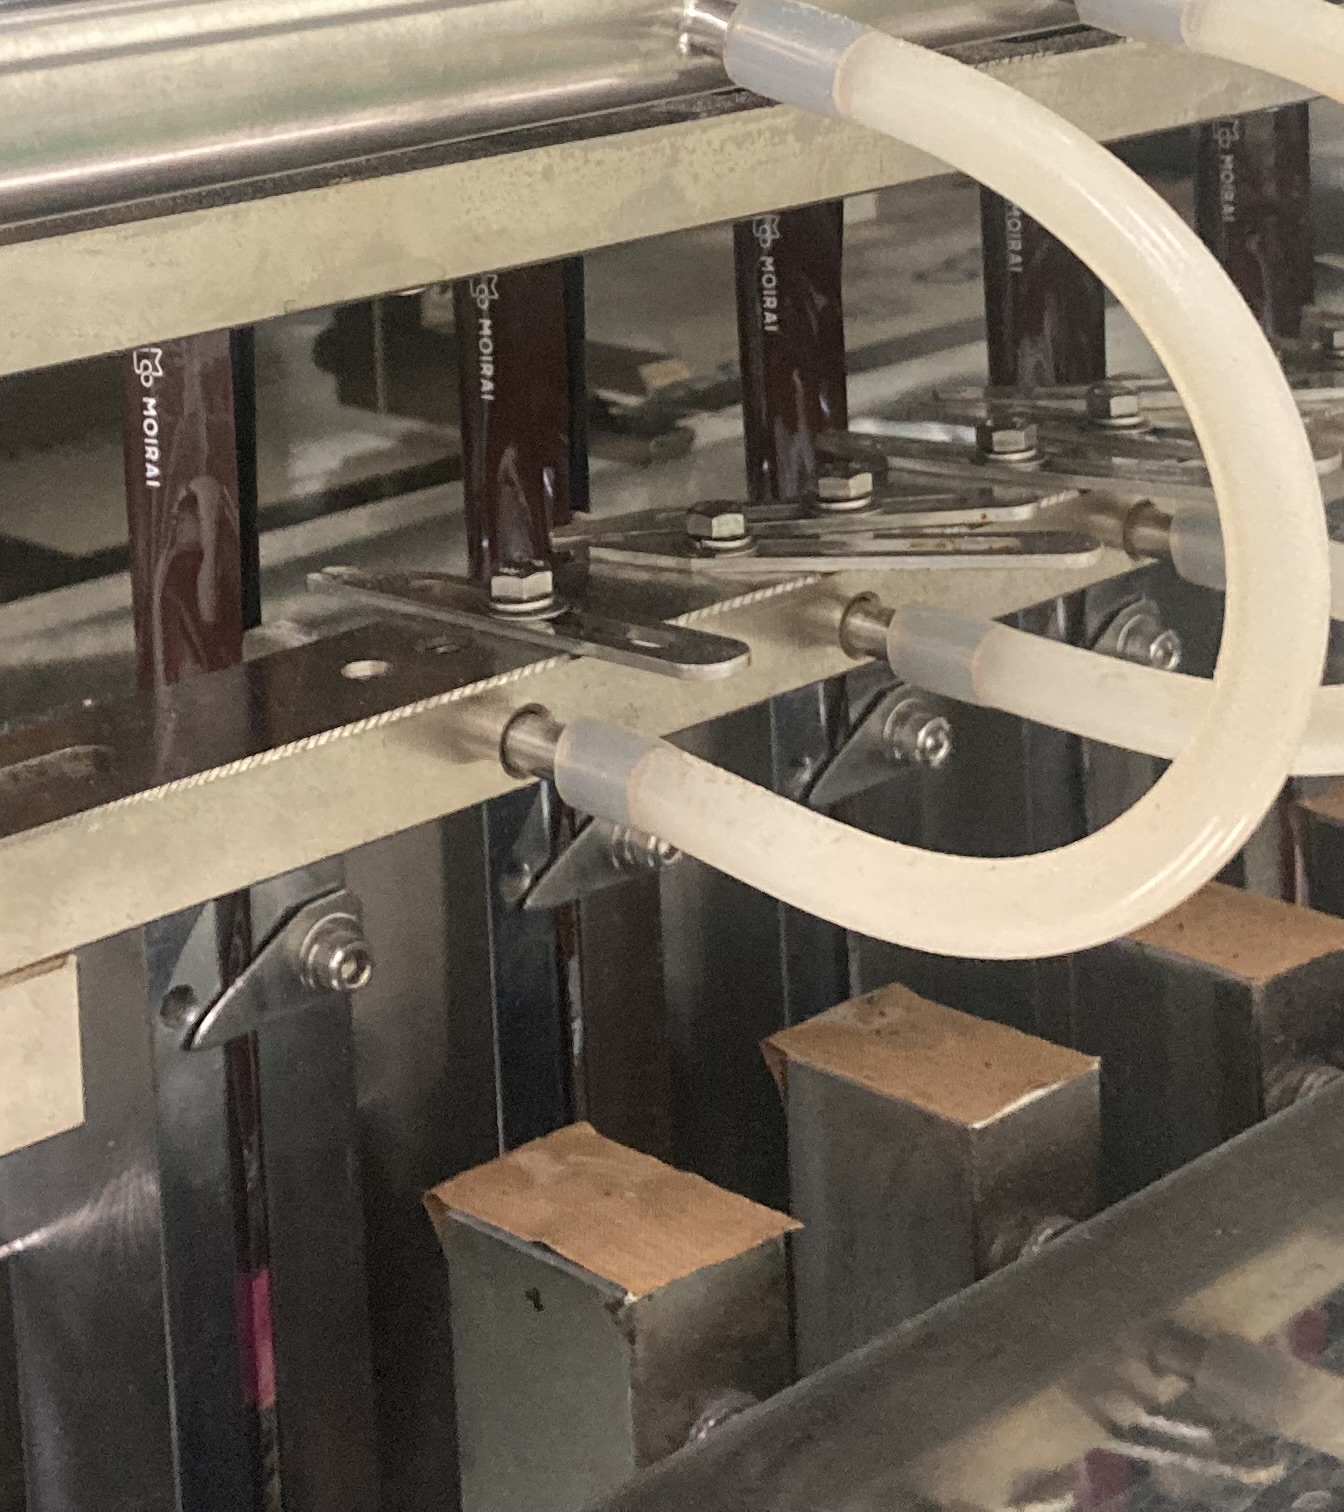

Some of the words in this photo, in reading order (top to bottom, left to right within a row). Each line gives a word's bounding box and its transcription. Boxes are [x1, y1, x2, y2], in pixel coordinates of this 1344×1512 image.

[1219, 154, 1236, 222] MOIRAI
[759, 255, 779, 331] MOIRAI
[478, 318, 495, 401] MOIRAI
[142, 396, 161, 488] MOIRAI
